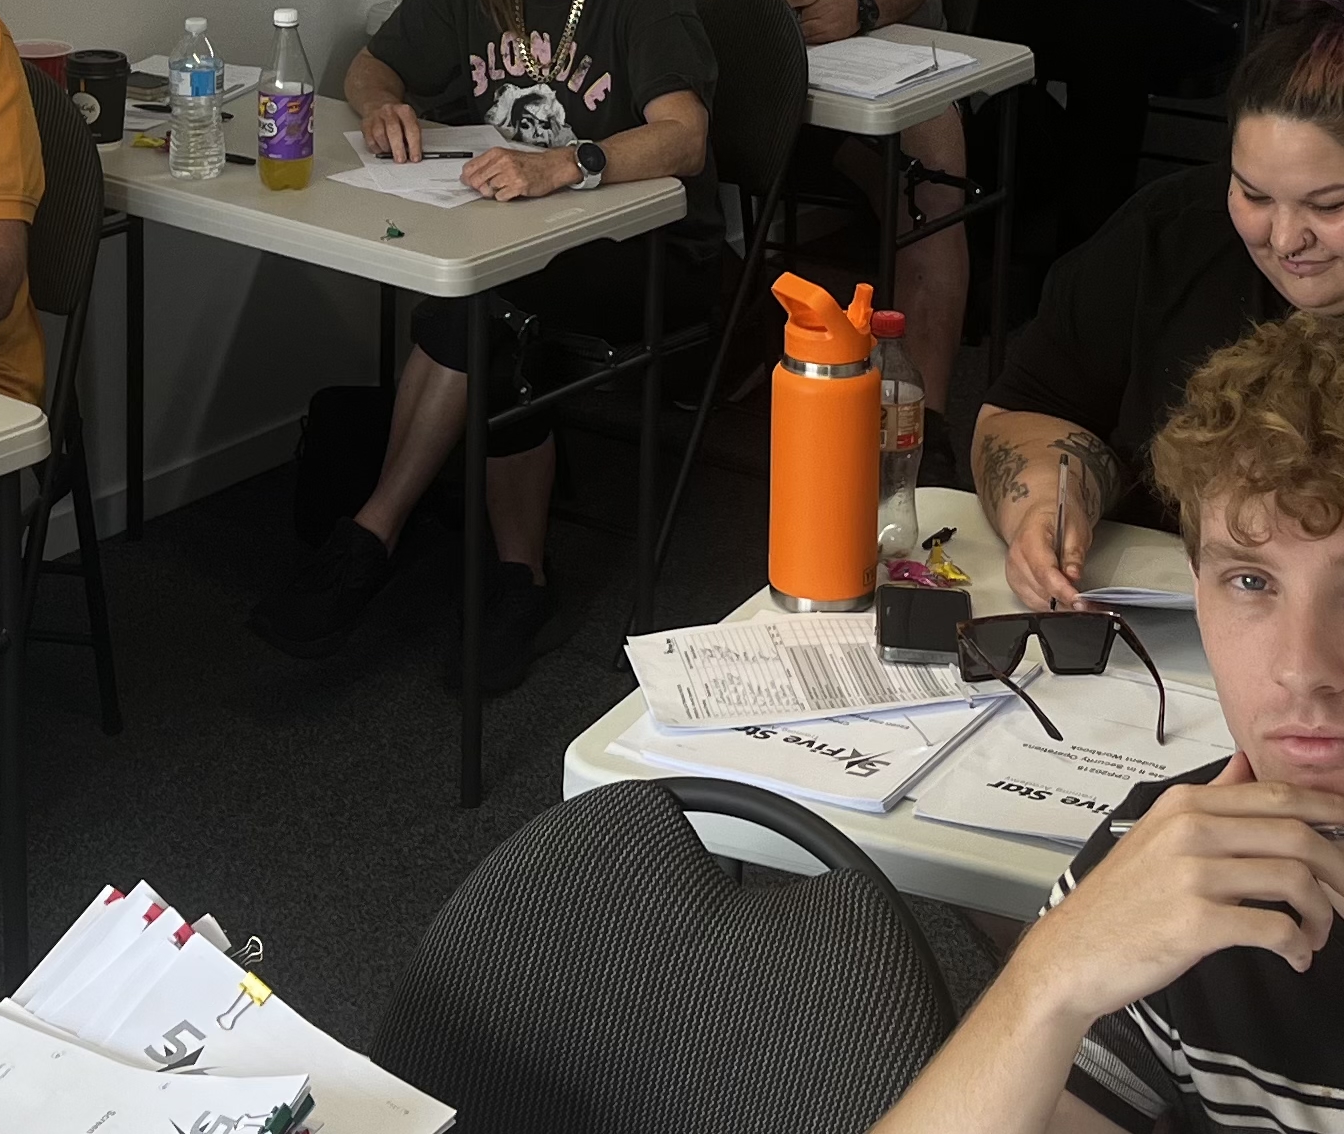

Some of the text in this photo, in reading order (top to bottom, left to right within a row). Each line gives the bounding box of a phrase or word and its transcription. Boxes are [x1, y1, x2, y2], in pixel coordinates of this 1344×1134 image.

[782, 734, 846, 757] Five
[1021, 742, 1079, 762] Operations
[1069, 744, 1168, 772] Student Workbook
[1080, 755, 1124, 770] Security
[986, 779, 1054, 801] Star
